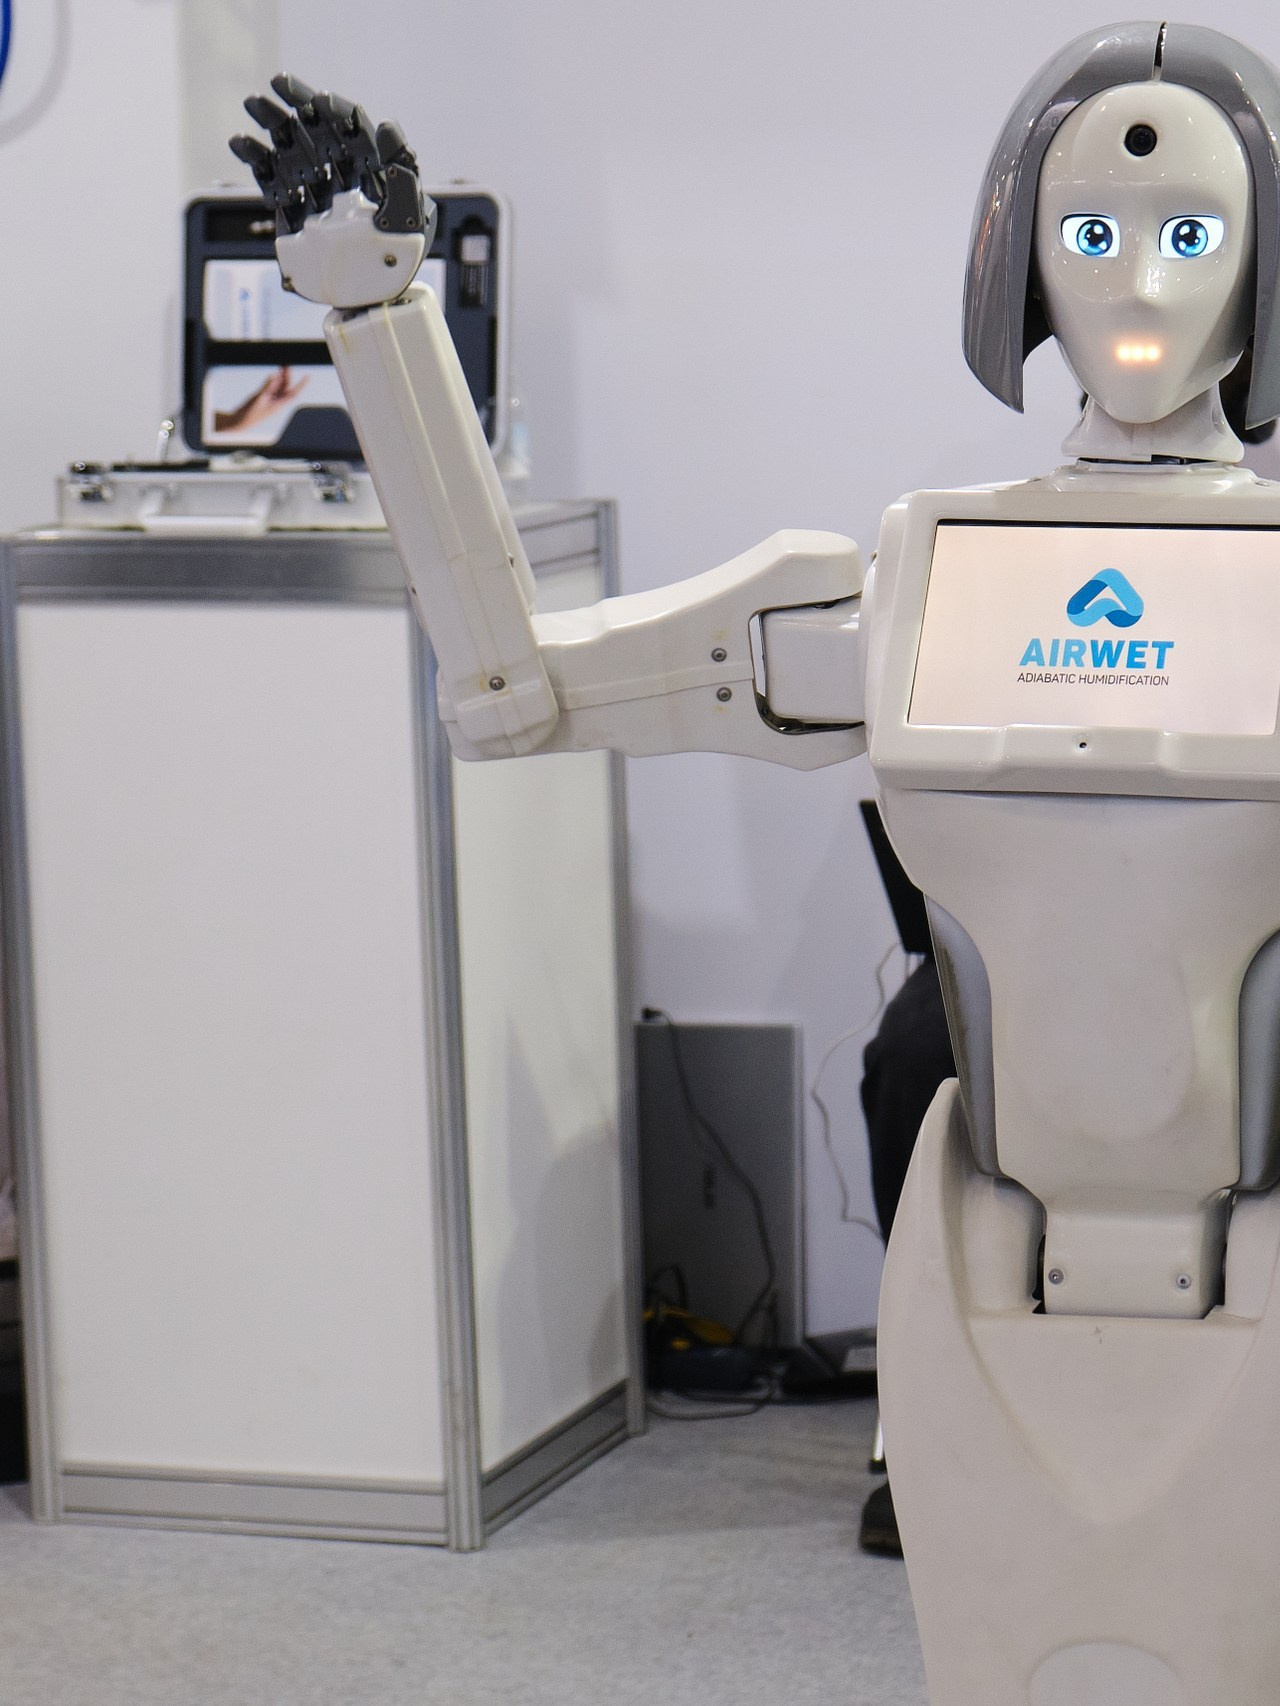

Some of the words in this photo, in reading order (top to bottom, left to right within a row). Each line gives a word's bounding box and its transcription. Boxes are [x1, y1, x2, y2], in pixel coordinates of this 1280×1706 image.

[1019, 638, 1175, 669] AIRWET
[1017, 672, 1076, 684] ADIABATIC
[1078, 674, 1170, 686] HUMIDIFICATION
